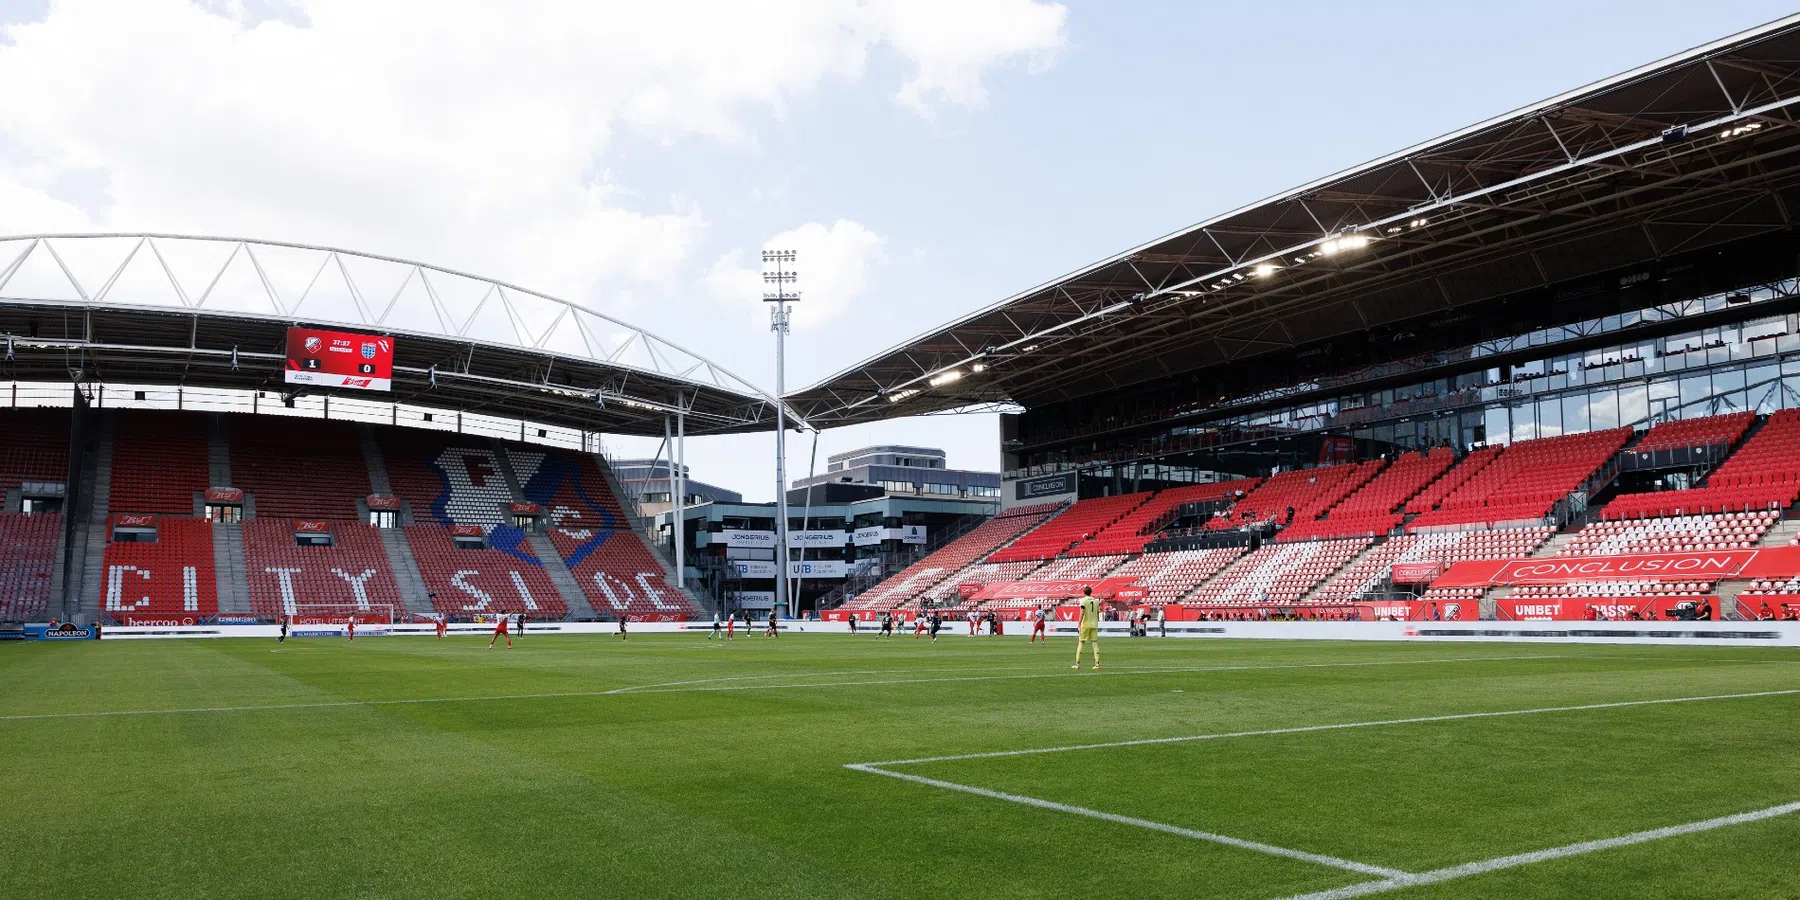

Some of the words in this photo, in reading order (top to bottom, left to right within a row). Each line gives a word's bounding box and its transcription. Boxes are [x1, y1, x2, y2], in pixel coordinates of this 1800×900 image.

[309, 360, 316, 368] 1
[363, 364, 371, 373] 0
[1398, 568, 1437, 577] CONCLUSION
[1513, 556, 1732, 578] CONCLUSION
[105, 565, 377, 615] CITY
[450, 570, 681, 610] SIDE
[1090, 601, 1094, 613] 1
[1374, 606, 1411, 617] UNIBET
[1515, 605, 1560, 616] UNIBET
